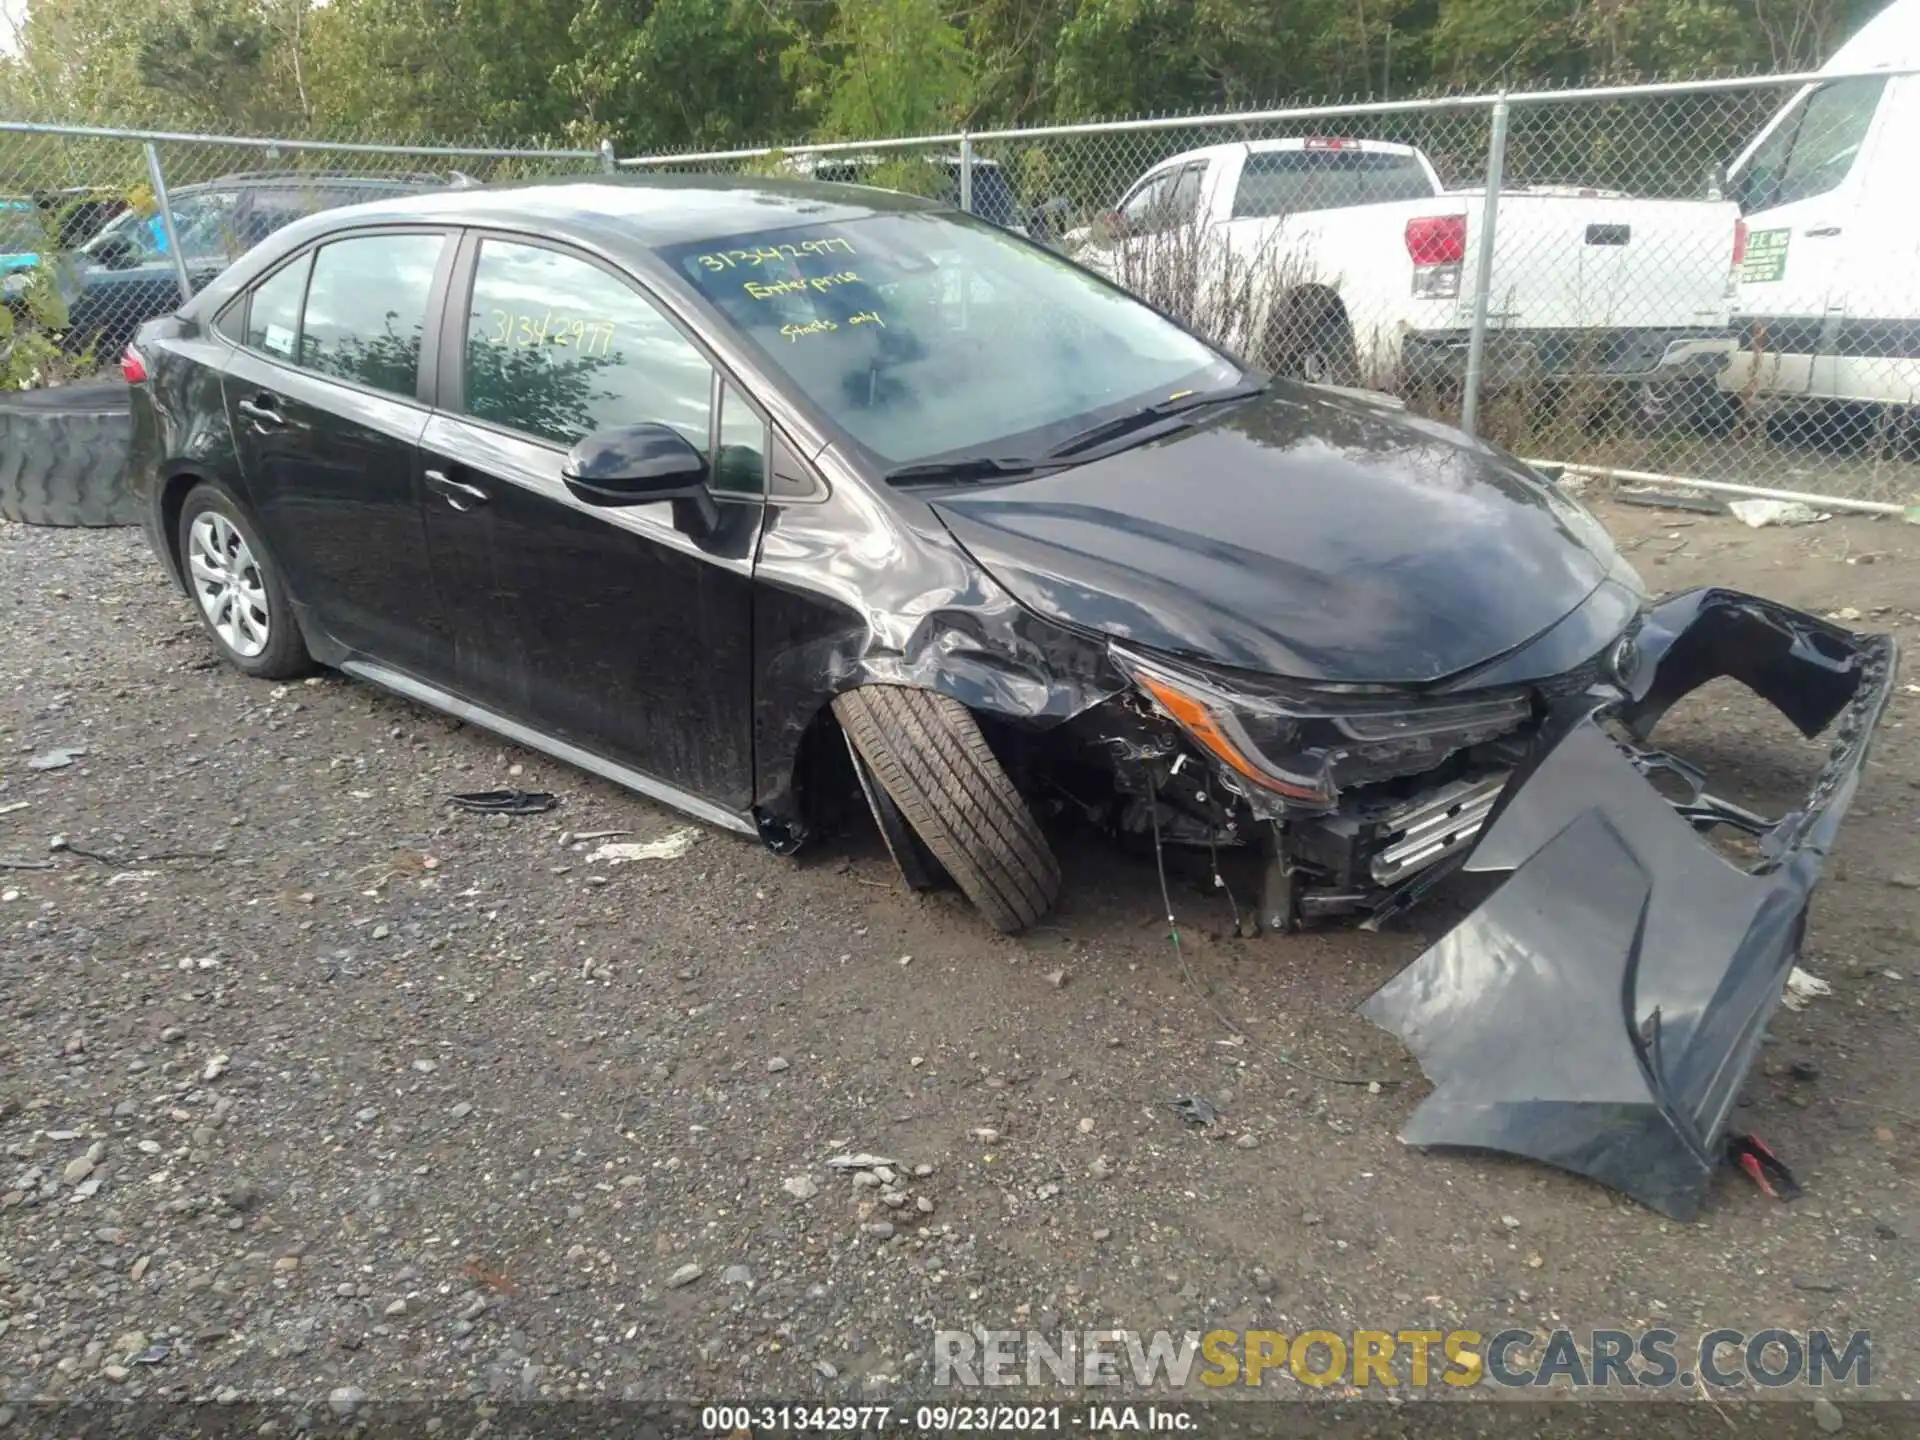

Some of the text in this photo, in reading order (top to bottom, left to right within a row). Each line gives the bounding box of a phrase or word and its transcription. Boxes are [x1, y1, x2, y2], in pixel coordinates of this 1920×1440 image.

[698, 237, 857, 272] 31342977
[489, 309, 616, 356] 31342977
[848, 311, 886, 329] only
